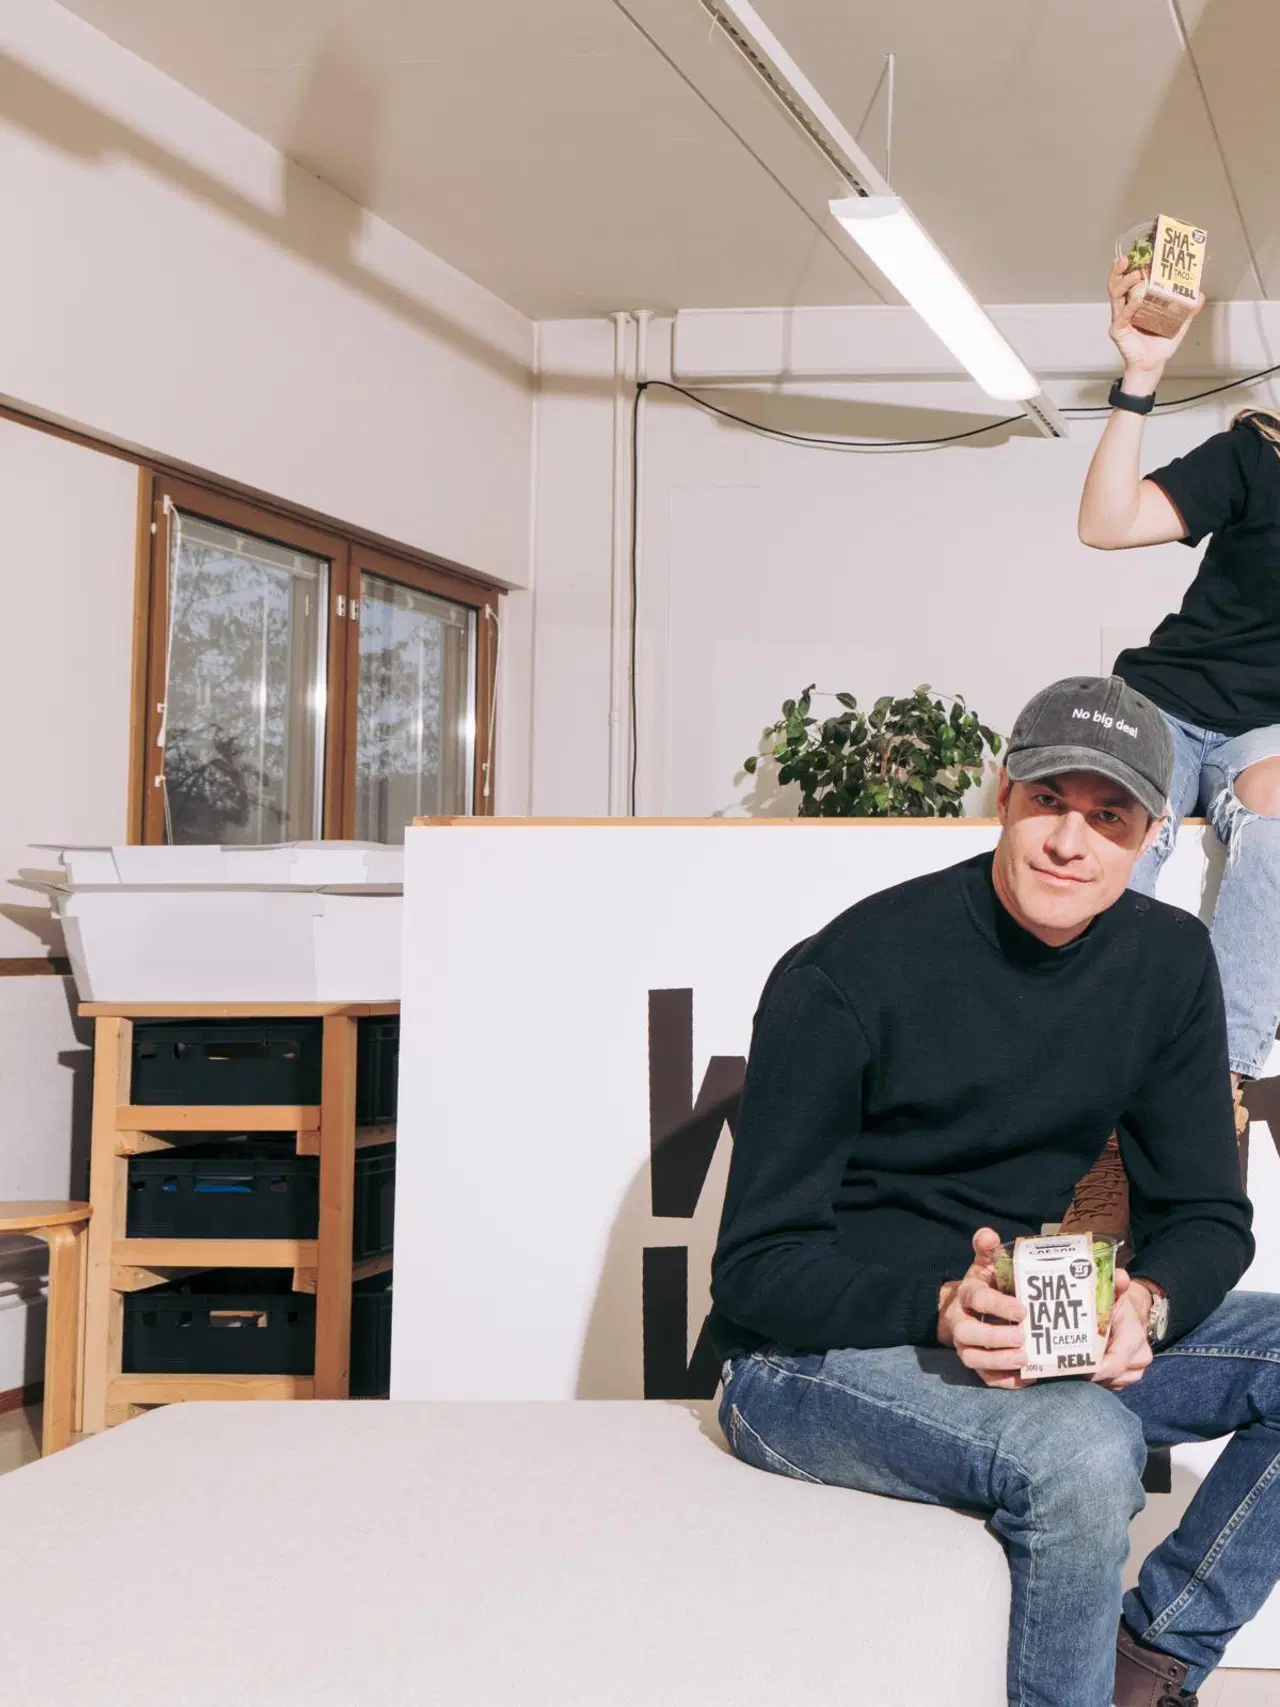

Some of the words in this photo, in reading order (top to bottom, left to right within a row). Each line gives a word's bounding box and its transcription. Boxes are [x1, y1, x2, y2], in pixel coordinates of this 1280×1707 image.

[1164, 227, 1195, 251] SHA-
[1160, 244, 1197, 272] LAAT-
[1160, 262, 1173, 280] TI
[1172, 283, 1197, 300] REBL
[1072, 708, 1090, 720] No
[1093, 710, 1114, 728] big
[1116, 719, 1138, 738] deal
[1027, 1274, 1077, 1301] SHA-
[1029, 1300, 1088, 1331] LAAT-
[1031, 1327, 1052, 1355] TI
[1053, 1334, 1088, 1346] CAESAR
[1057, 1352, 1096, 1369] REBL
